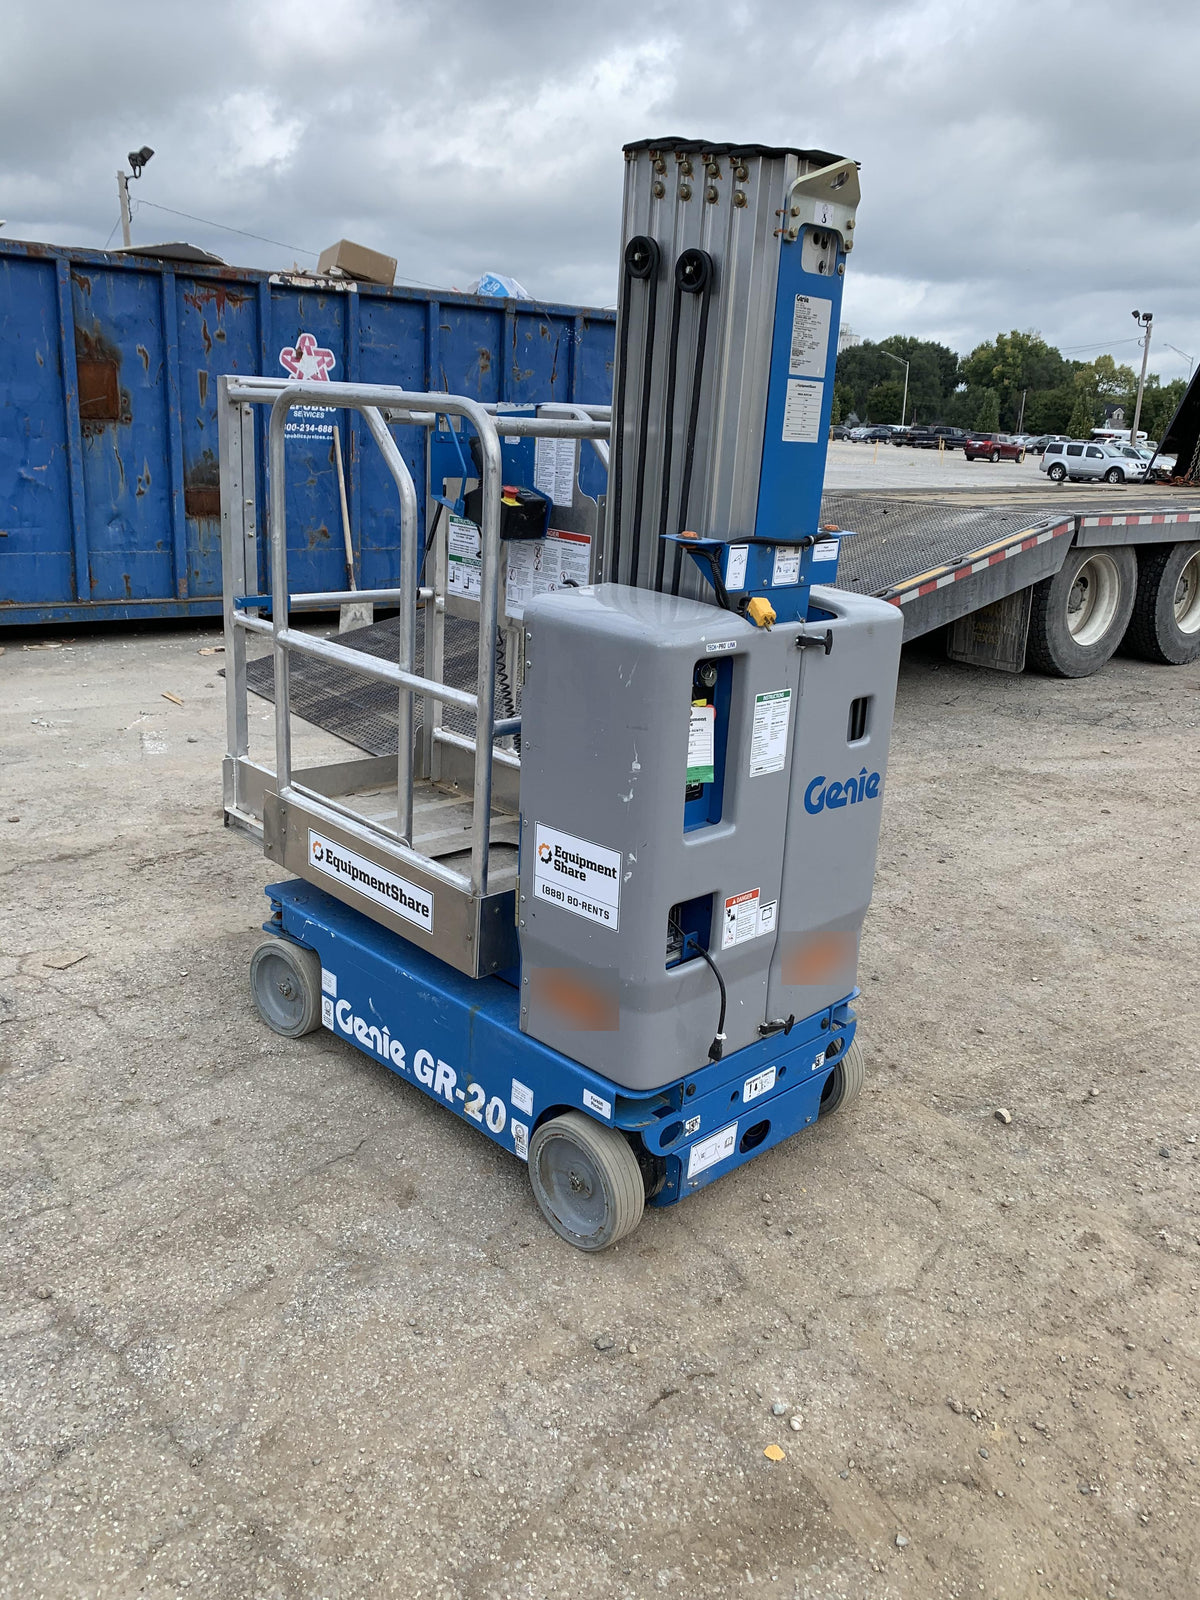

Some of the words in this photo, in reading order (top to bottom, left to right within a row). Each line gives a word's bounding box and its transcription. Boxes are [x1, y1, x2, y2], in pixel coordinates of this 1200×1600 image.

[804, 766, 881, 815] Genie
[553, 859, 587, 882] Share
[554, 844, 618, 880] Equipment
[325, 848, 430, 918] EquipmentShare
[736, 892, 753, 904] DANGER
[542, 884, 565, 902] (888)
[567, 895, 610, 920] 80-RENTS
[335, 998, 407, 1071] Genie
[413, 1048, 507, 1134] GR-20
